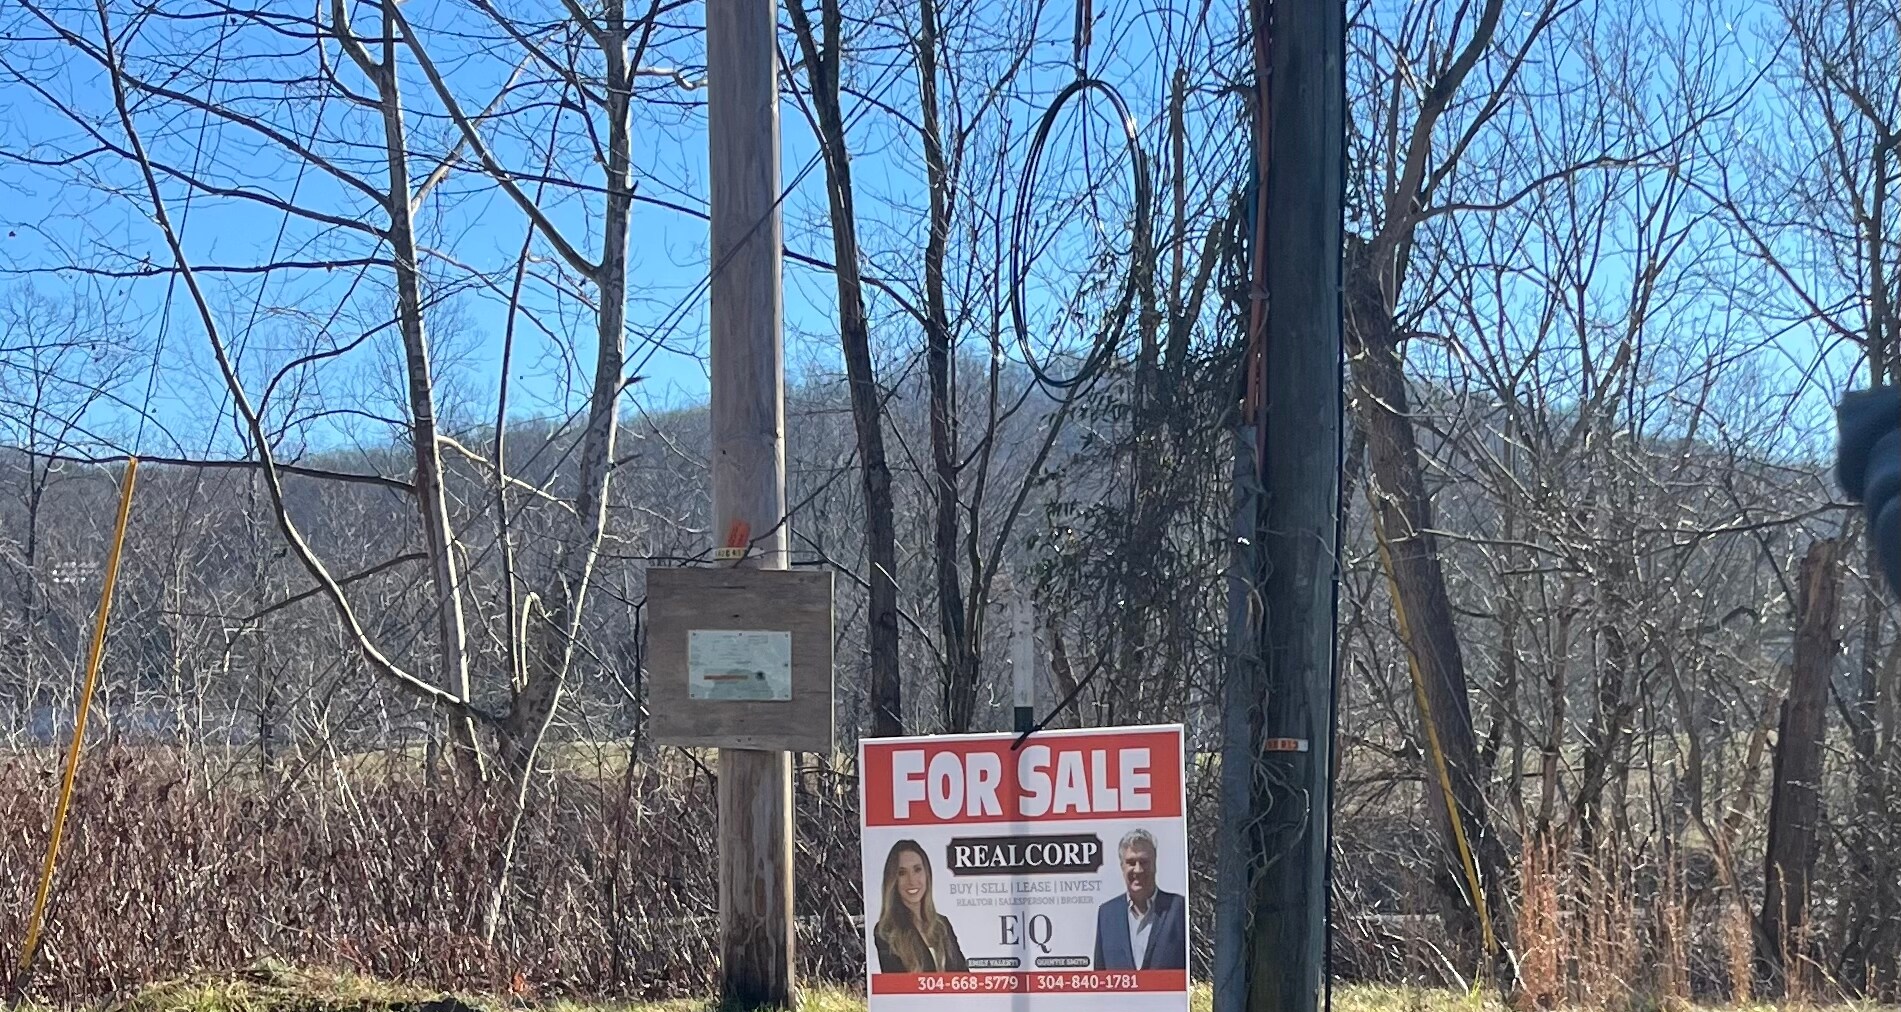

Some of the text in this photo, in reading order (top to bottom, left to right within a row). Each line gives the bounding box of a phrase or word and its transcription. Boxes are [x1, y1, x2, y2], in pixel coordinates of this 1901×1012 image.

[892, 745, 1152, 820] FOR SALE
[954, 842, 1097, 868] REALCORP
[950, 880, 1102, 895] BUY SELL LEASE INVEST
[957, 895, 1094, 907] REALTOR SALESPERSON BROKER
[917, 974, 1139, 991] 304-668-5779 304-840-1781
